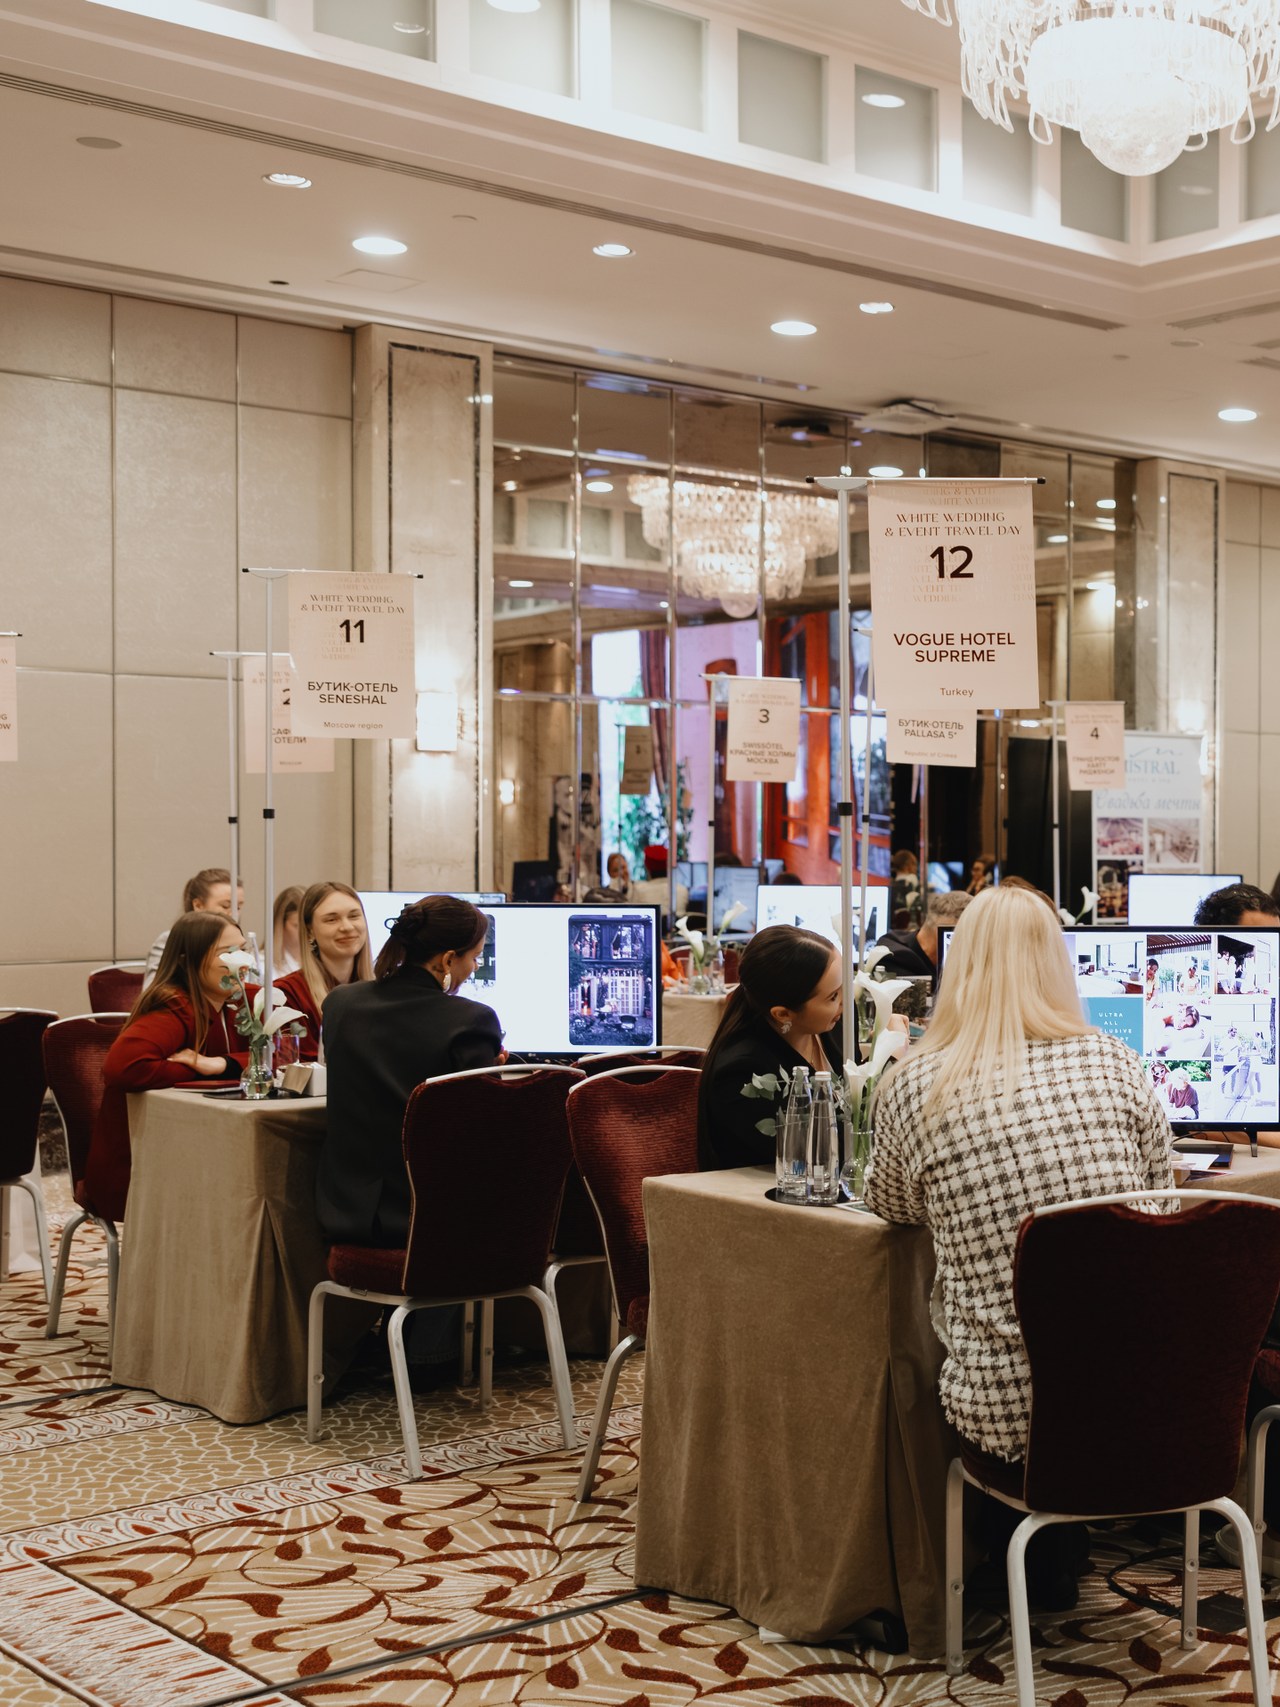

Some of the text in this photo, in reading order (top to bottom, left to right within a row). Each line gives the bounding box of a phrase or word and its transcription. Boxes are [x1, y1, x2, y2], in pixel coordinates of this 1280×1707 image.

[896, 512, 1005, 523] WHITE WEDDING
[884, 525, 1022, 537] & EVENT TRAVEL DAY
[929, 545, 974, 579] 12
[310, 594, 394, 604] WHITE WEDDING
[311, 604, 344, 613] EVENT
[347, 604, 384, 614] TRAVEL
[387, 606, 406, 614] DAY
[339, 619, 364, 643] 11
[893, 632, 1015, 646] VOGUE HOTEL
[915, 649, 996, 663] SUPREME
[308, 681, 398, 693] БУТИК-ОТЕЛЬ
[939, 687, 974, 697] Turkey
[319, 693, 387, 705] SENESHAL
[758, 708, 770, 724] 3
[323, 721, 384, 731] Moscow region
[898, 718, 964, 730] БУТИК-ОТЕЛЬ
[904, 729, 946, 739] PALLASA
[1089, 726, 1100, 740] 4
[274, 736, 307, 744] ОТЕЛИ
[729, 749, 765, 757] КРАСНЫЕ
[746, 757, 779, 765] МОСКВА
[1124, 759, 1180, 775] ISTRAL
